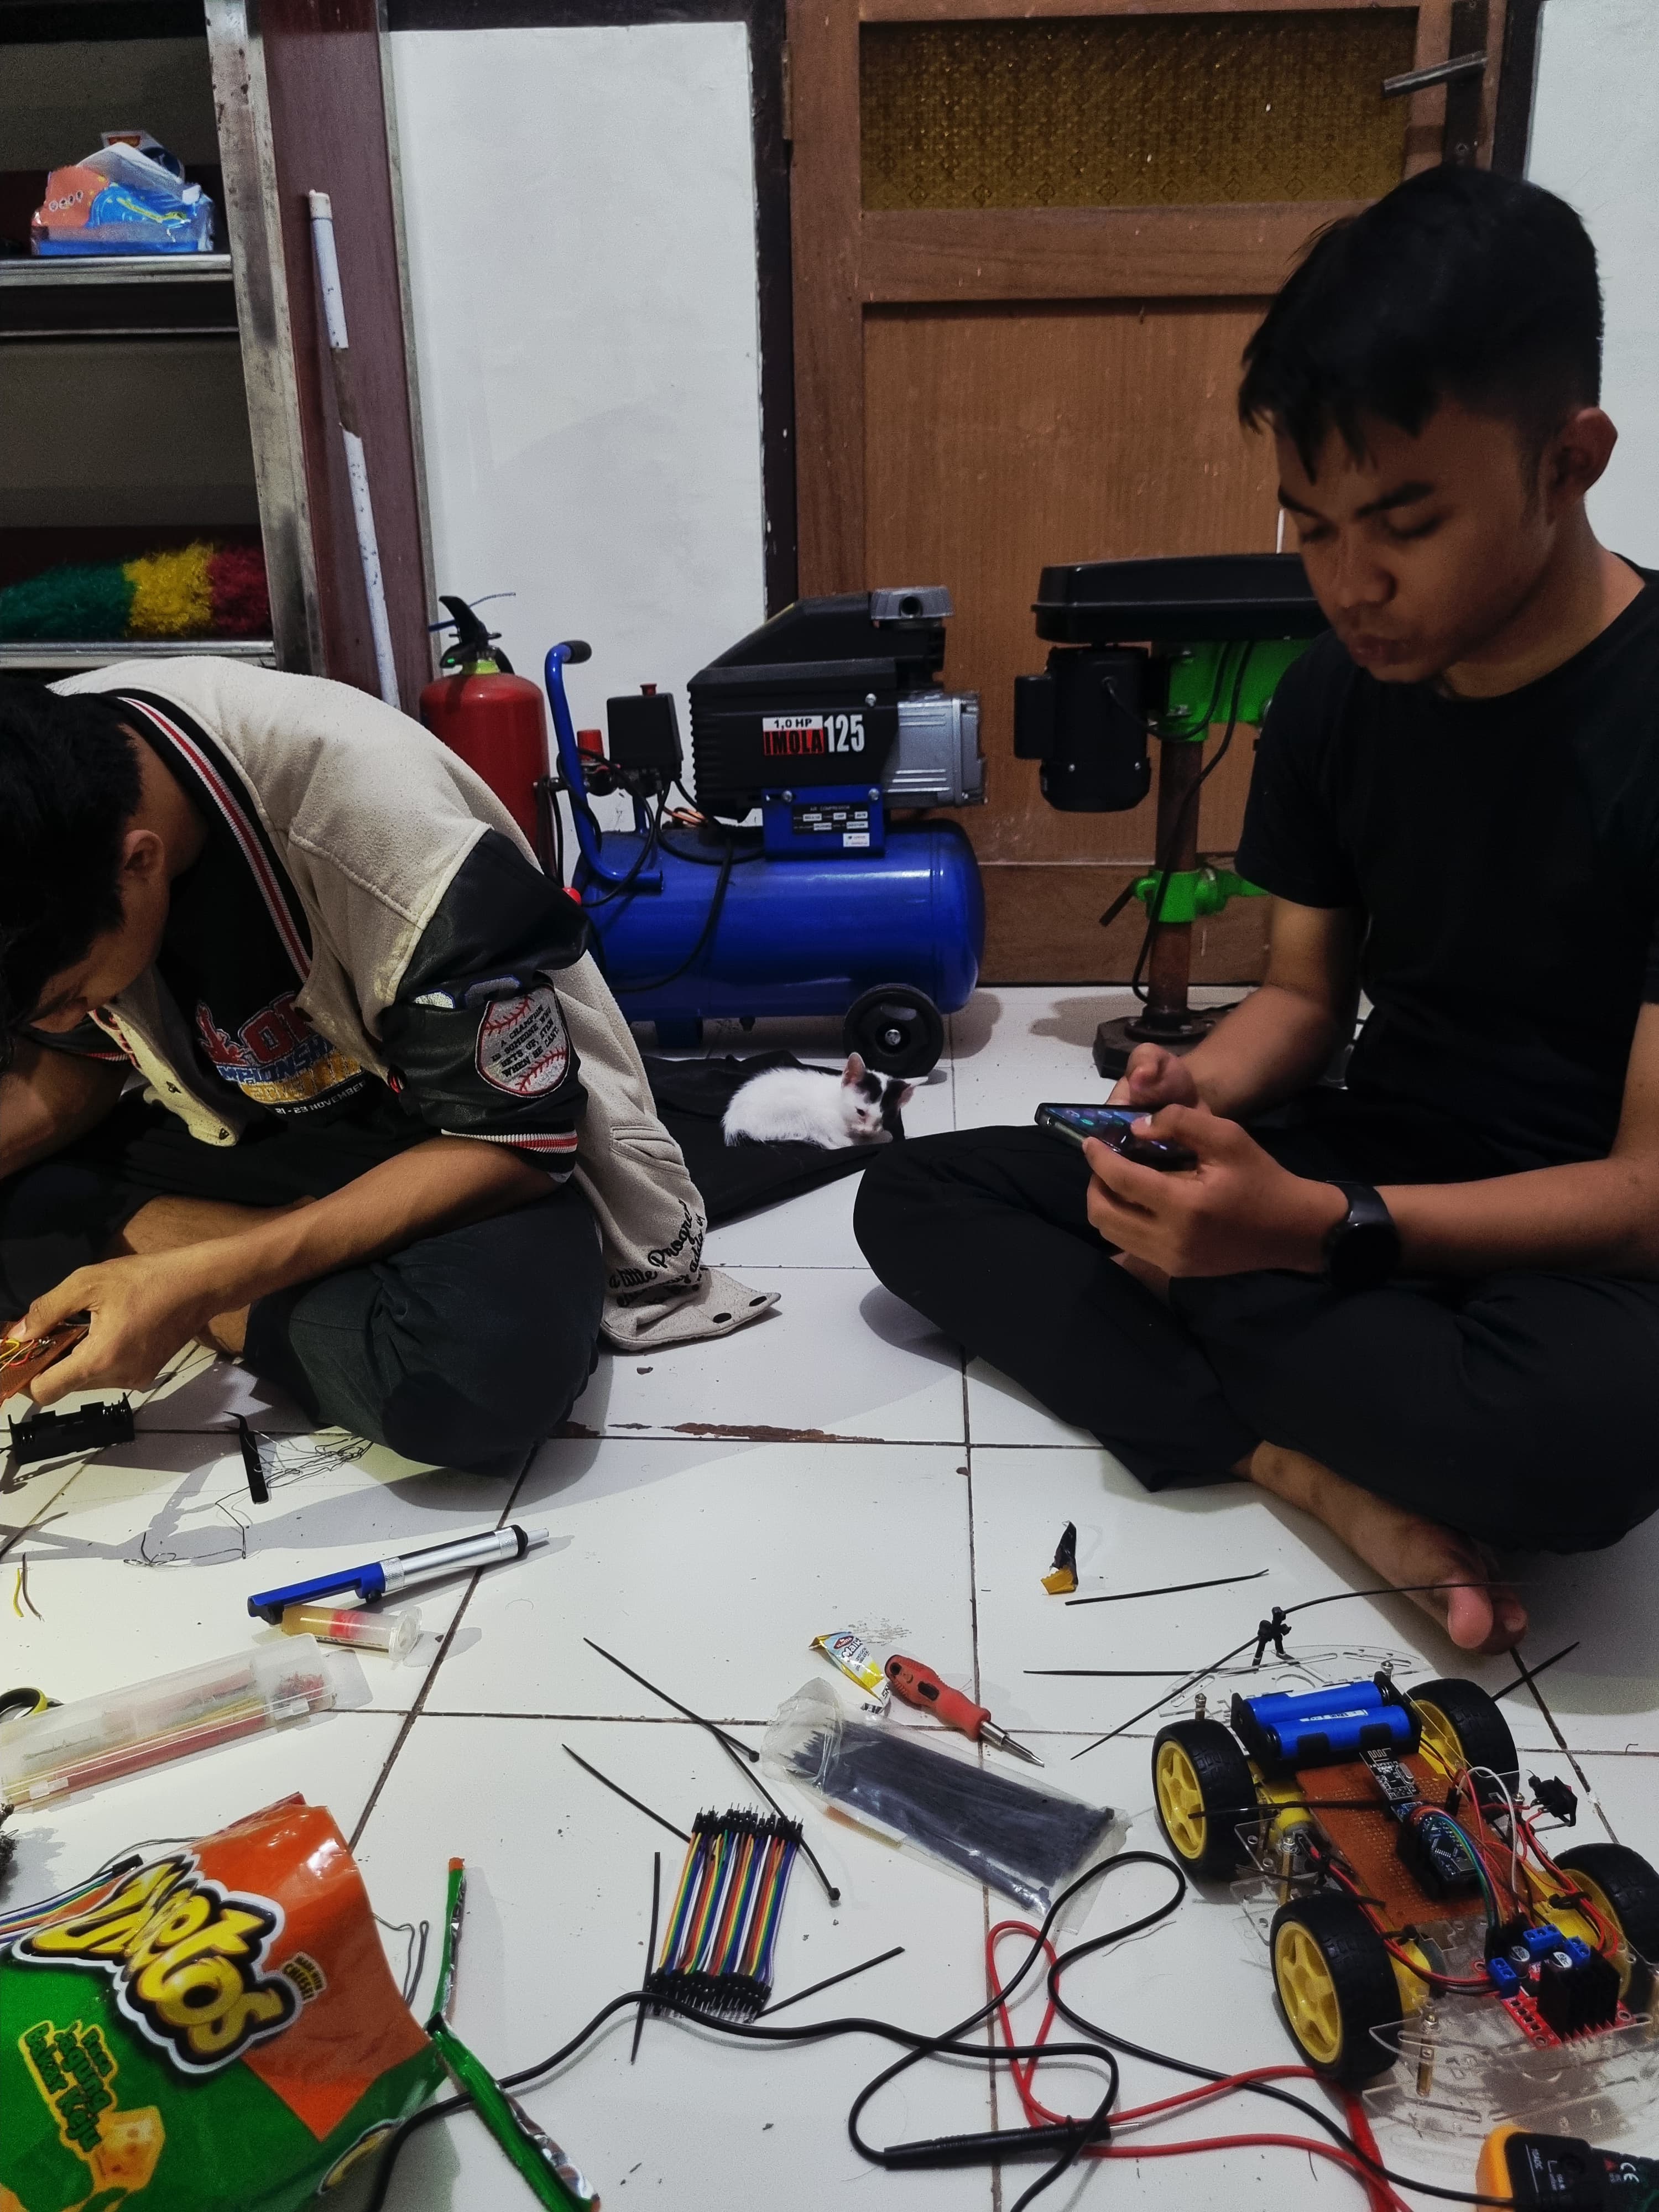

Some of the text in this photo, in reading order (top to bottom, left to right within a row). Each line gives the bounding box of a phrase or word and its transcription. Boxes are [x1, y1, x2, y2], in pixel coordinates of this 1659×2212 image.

[765, 714, 865, 754] IMOLA 125
[774, 718, 812, 730] 1,0 HP
[509, 1005, 544, 1039] CHAMPION
[504, 1024, 539, 1053] SOMEONE
[502, 1058, 531, 1077] WHEN
[532, 1046, 543, 1058] HE
